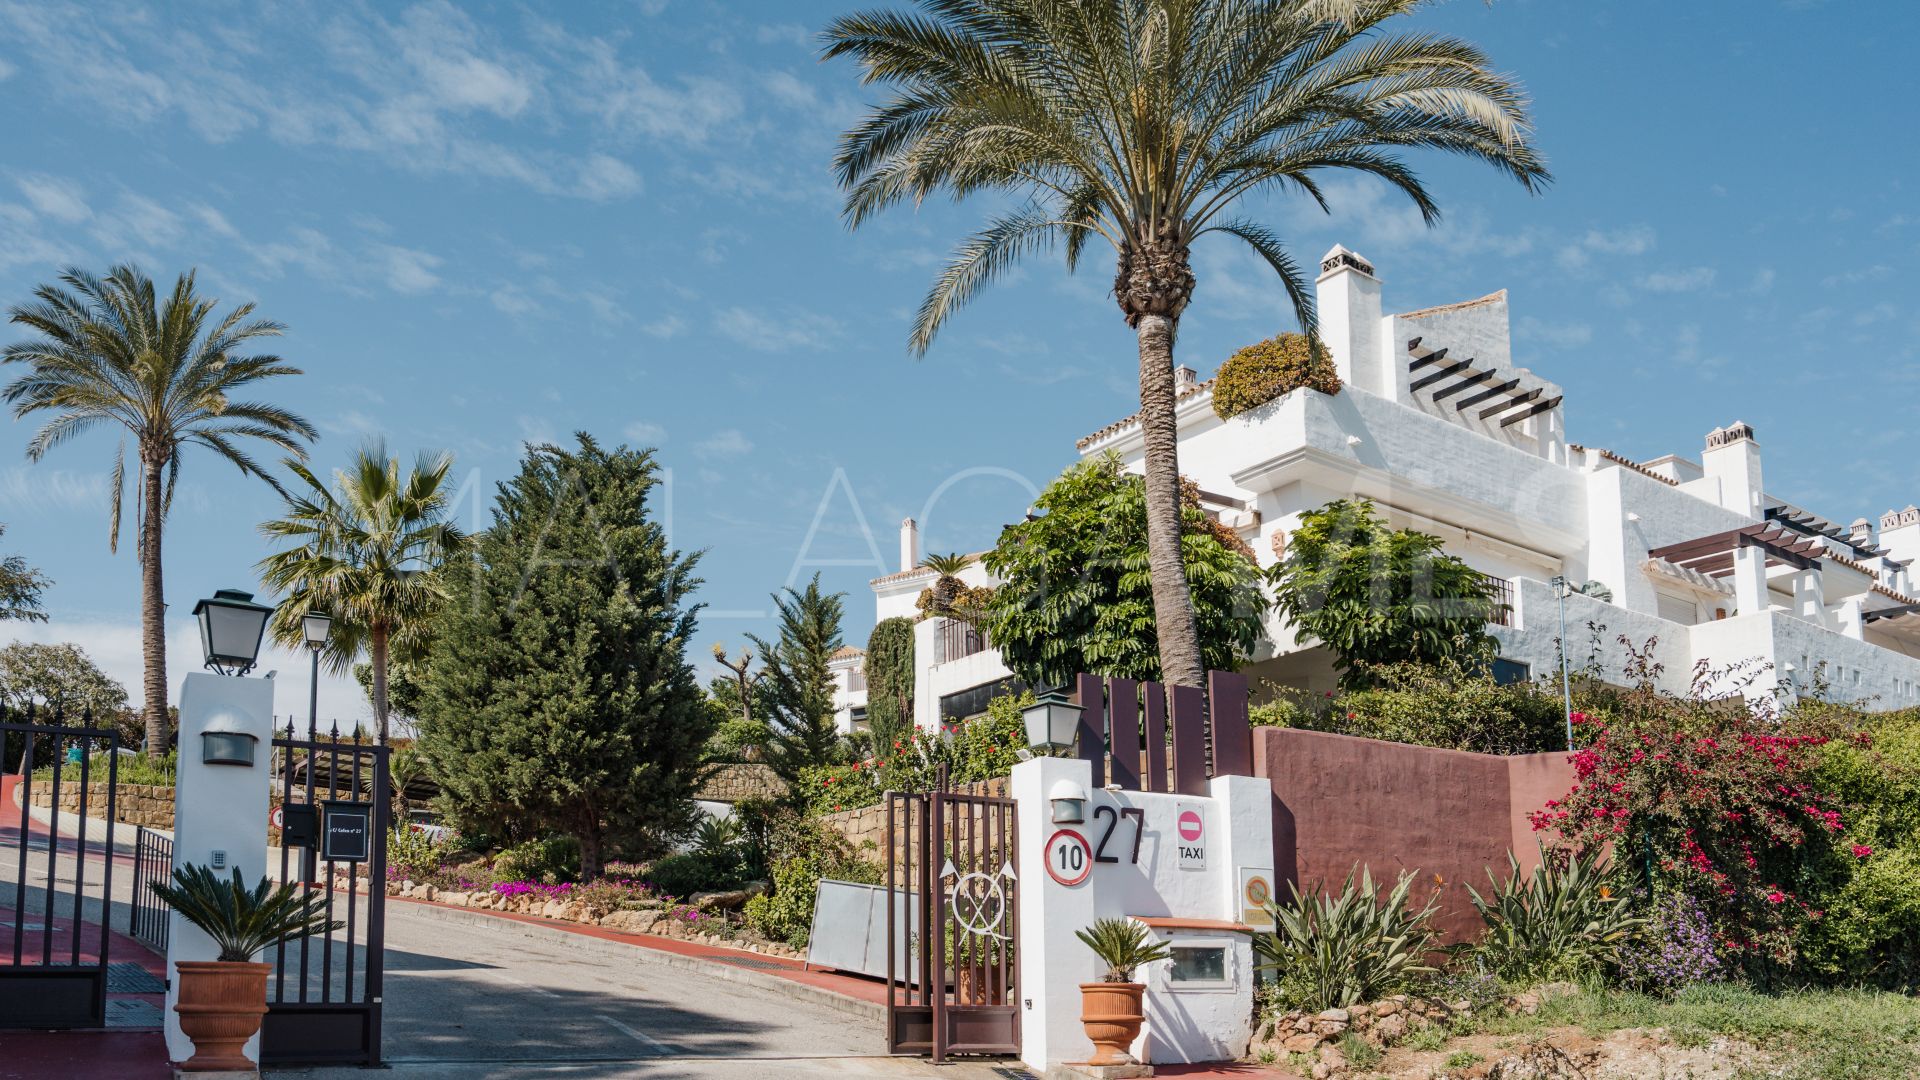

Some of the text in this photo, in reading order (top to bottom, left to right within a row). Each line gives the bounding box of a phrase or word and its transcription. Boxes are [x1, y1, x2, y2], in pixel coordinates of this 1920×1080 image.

[1094, 805, 1144, 864] 27
[1058, 844, 1083, 871] 10
[1178, 847, 1204, 860] TAXI
